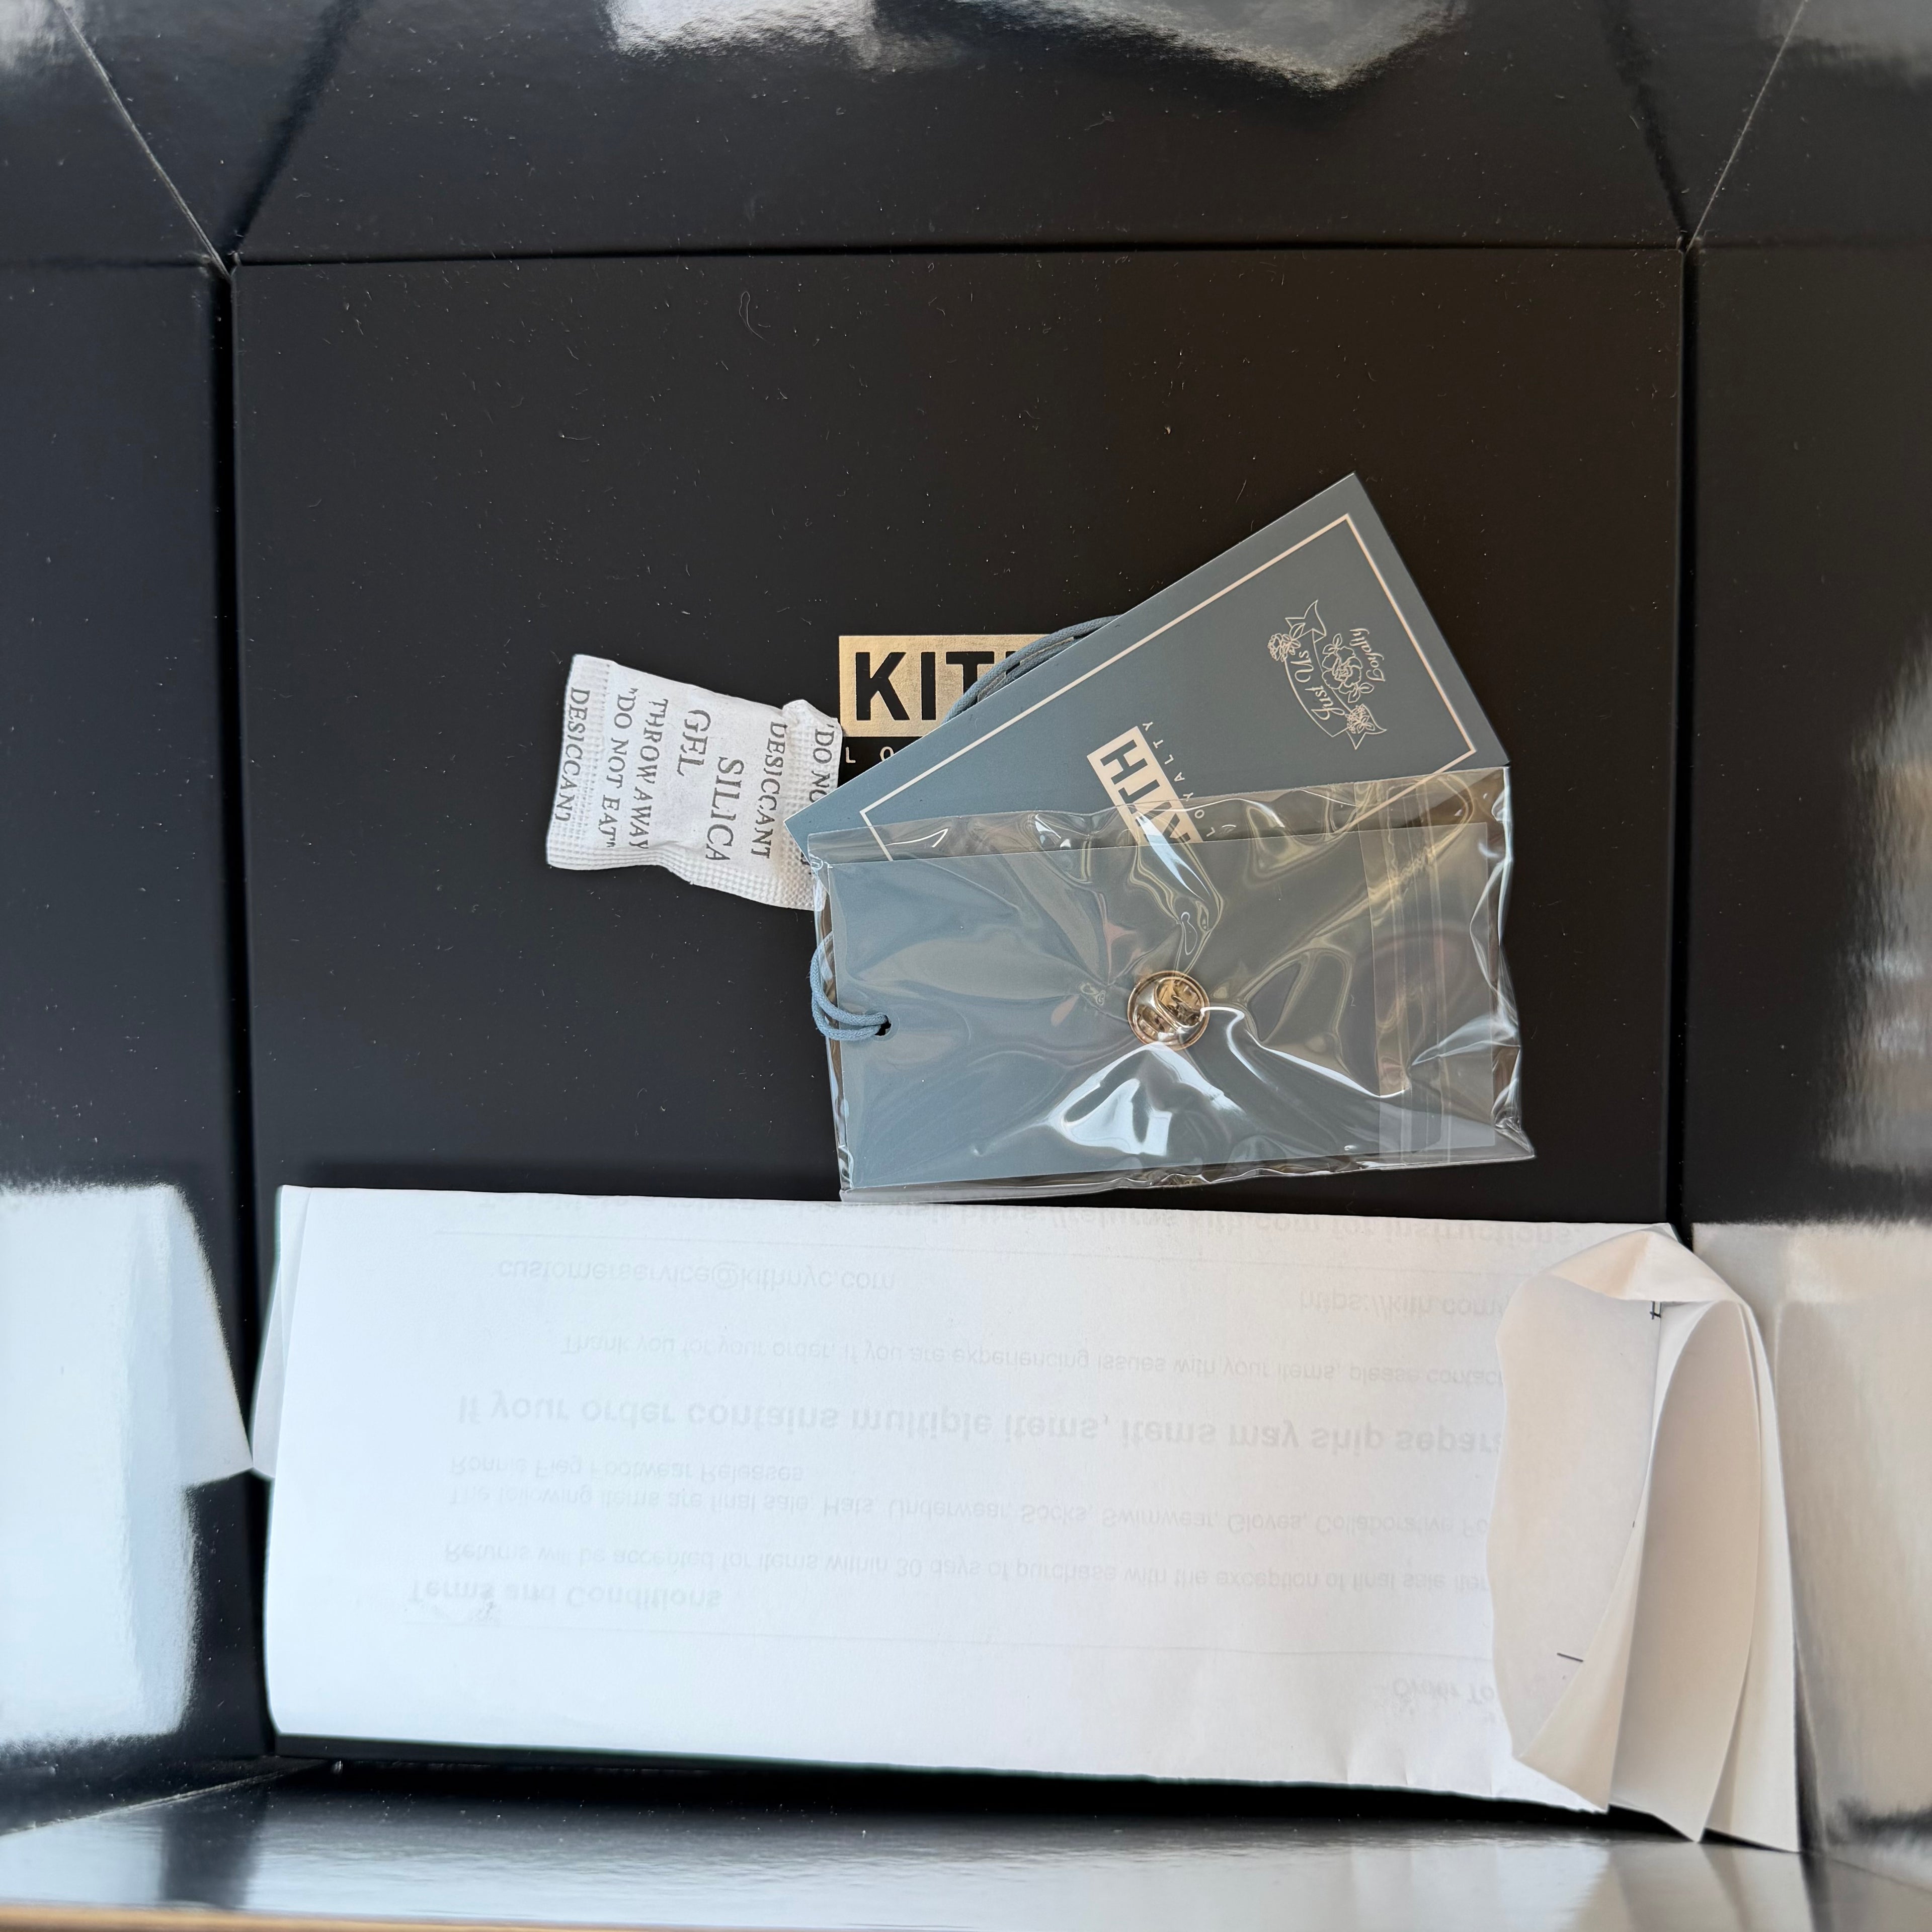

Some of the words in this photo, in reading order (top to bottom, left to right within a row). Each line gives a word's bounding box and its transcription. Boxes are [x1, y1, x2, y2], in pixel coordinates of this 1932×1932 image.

[855, 652, 1022, 721] KIT
[1291, 650, 1314, 683] Us
[1349, 628, 1386, 681] Loyalty
[1305, 686, 1345, 720] Just
[555, 687, 590, 822] DESICCANT
[607, 738, 629, 788] NOT
[677, 710, 711, 776] GEL
[705, 756, 745, 860] SILICA
[751, 721, 787, 859] DESICCANT
[809, 770, 831, 803] NO
[1142, 721, 1216, 837] LOYALTY
